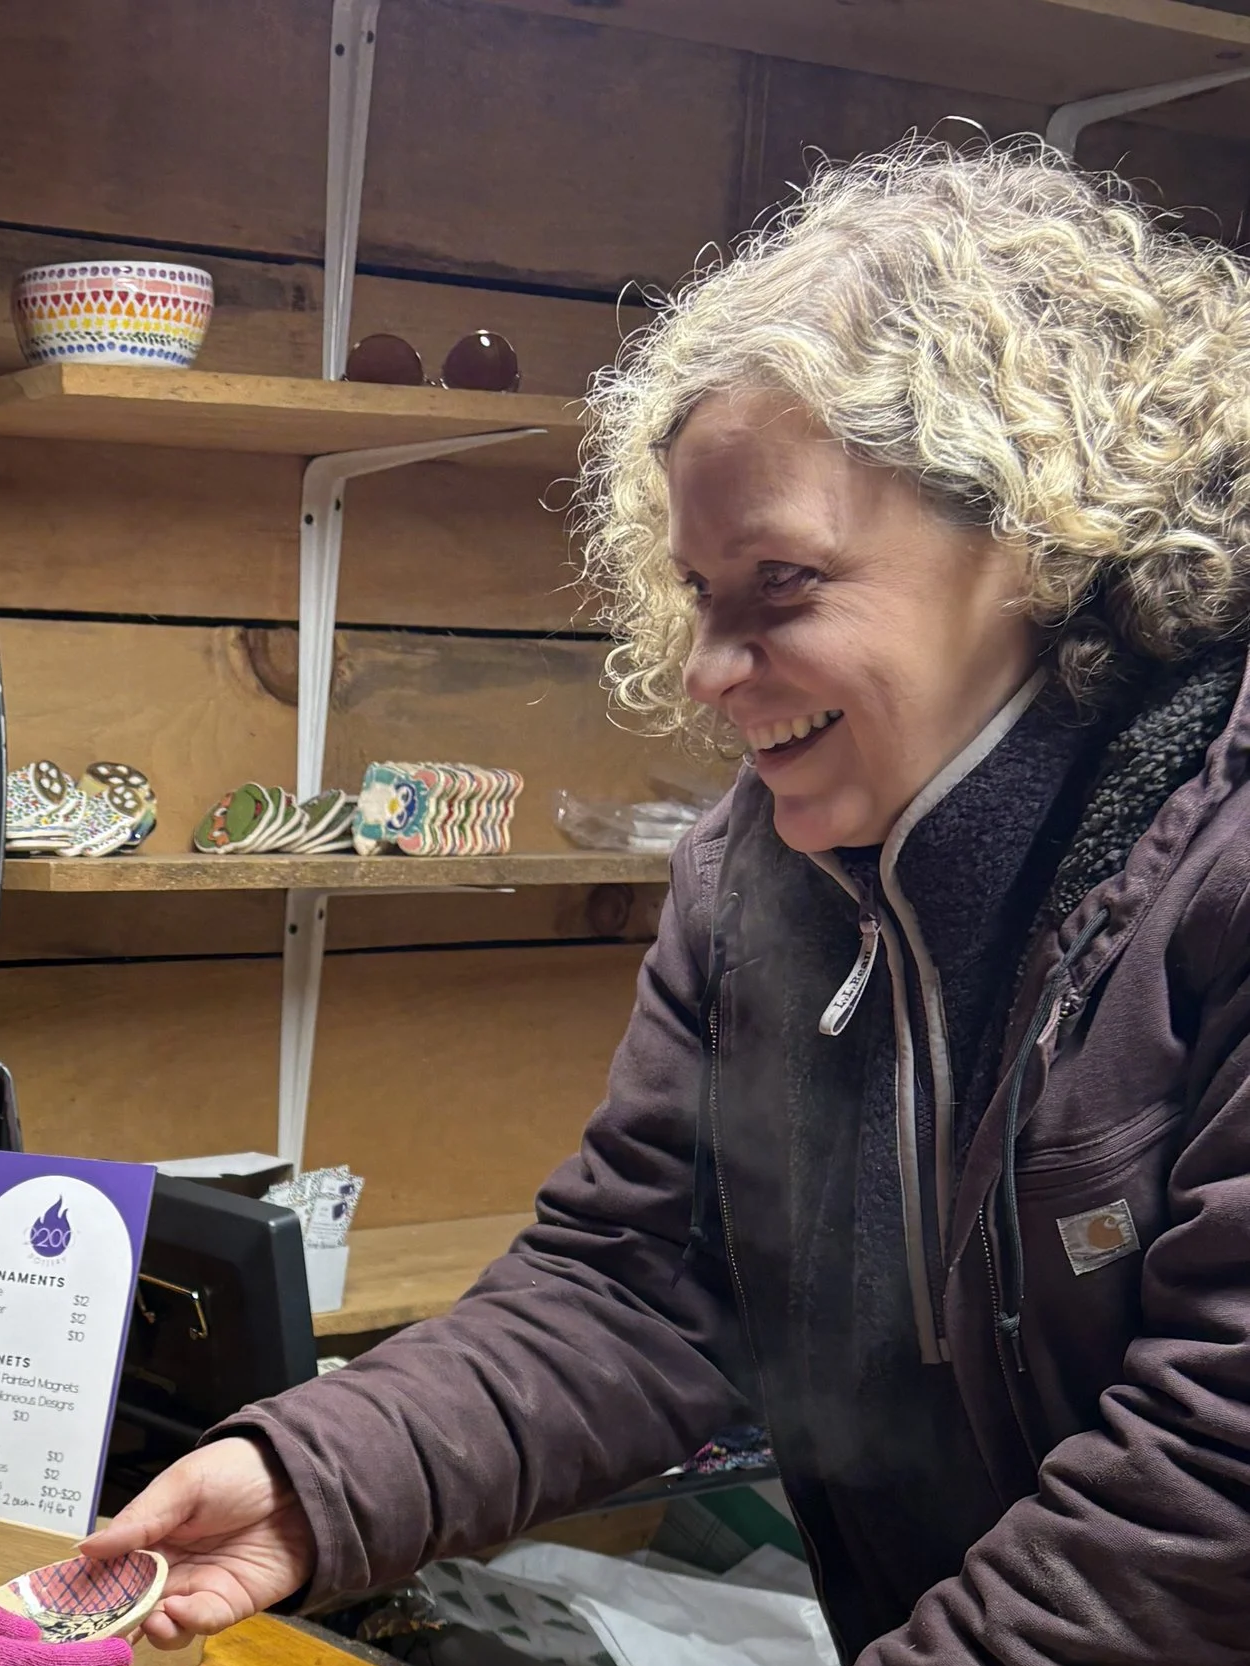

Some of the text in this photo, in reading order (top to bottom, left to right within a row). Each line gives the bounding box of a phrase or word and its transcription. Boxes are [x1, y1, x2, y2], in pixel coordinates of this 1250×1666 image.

[73, 1295, 90, 1308] $12
[70, 1312, 87, 1325] $12
[67, 1330, 85, 1343] $10
[1, 1373, 36, 1388] Painted
[37, 1378, 79, 1394] Magnets
[38, 1395, 75, 1411] Designs
[12, 1410, 30, 1422] $10
[46, 1450, 64, 1463] $10
[43, 1469, 60, 1481] $12
[40, 1485, 82, 1501] $10-$20
